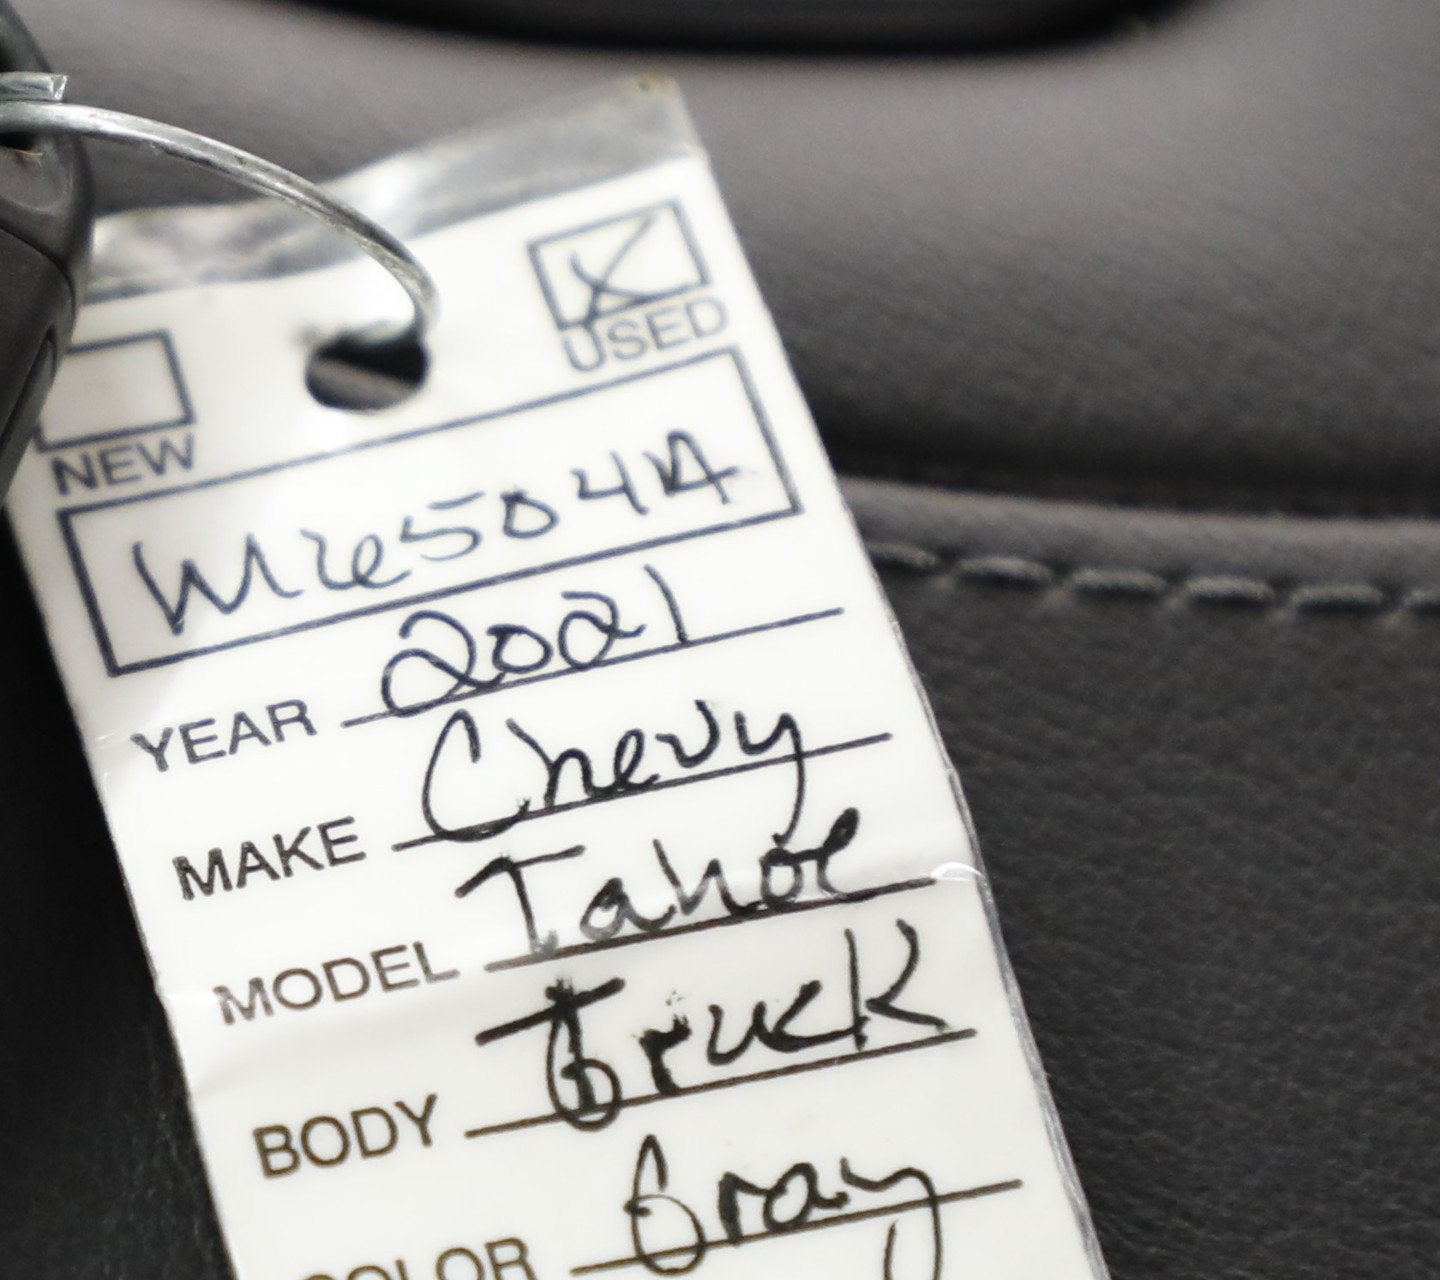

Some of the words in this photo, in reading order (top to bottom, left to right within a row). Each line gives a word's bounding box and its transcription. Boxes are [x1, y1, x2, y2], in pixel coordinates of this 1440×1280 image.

[560, 297, 728, 373] USED
[52, 435, 197, 495] NEW
[130, 698, 319, 776] YEAR
[381, 566, 688, 718] 2021
[171, 817, 367, 901] MAKE
[420, 698, 808, 842] Chevy
[216, 940, 461, 1026] MODEL
[455, 808, 859, 956] Tahoe
[253, 1095, 440, 1179] BODY
[475, 918, 947, 1131] Truck
